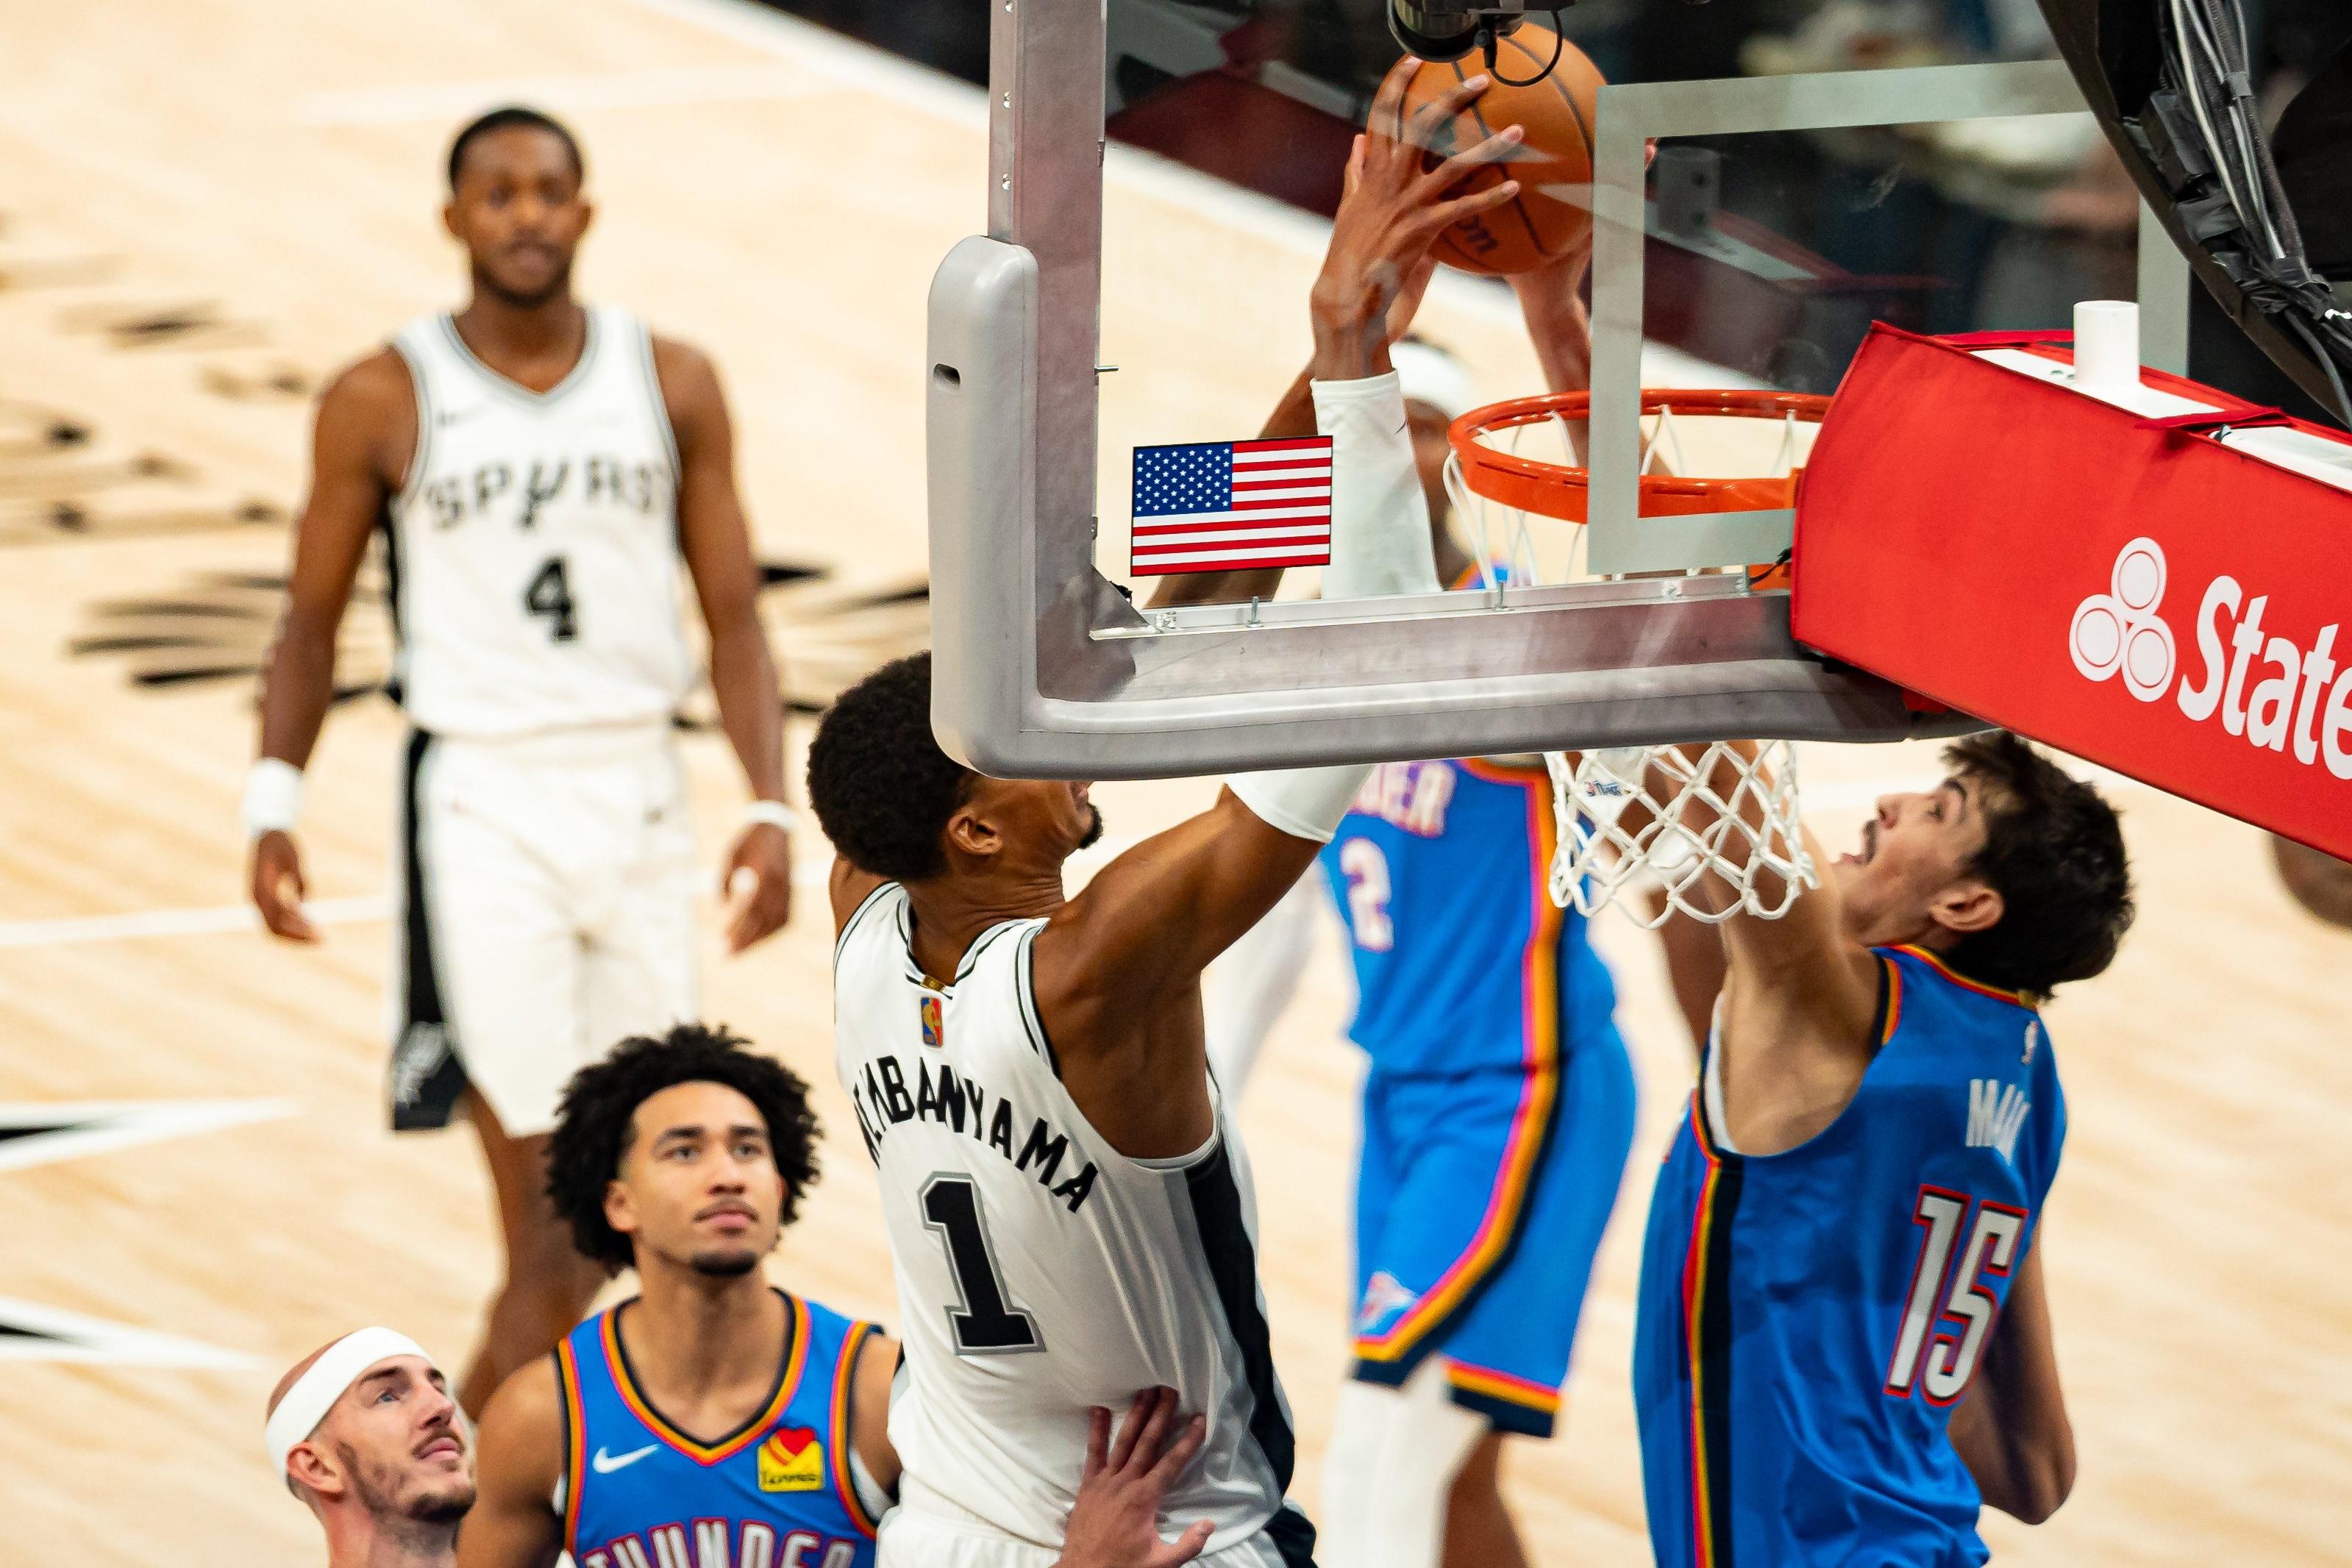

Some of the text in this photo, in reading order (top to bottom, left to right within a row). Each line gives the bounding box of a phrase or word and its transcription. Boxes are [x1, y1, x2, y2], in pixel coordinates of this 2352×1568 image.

[523, 555, 578, 641] 4
[2177, 574, 2352, 780] State
[1338, 837, 1394, 952] 2
[916, 1171, 1047, 1355] 1
[1884, 1184, 2030, 1408] 15
